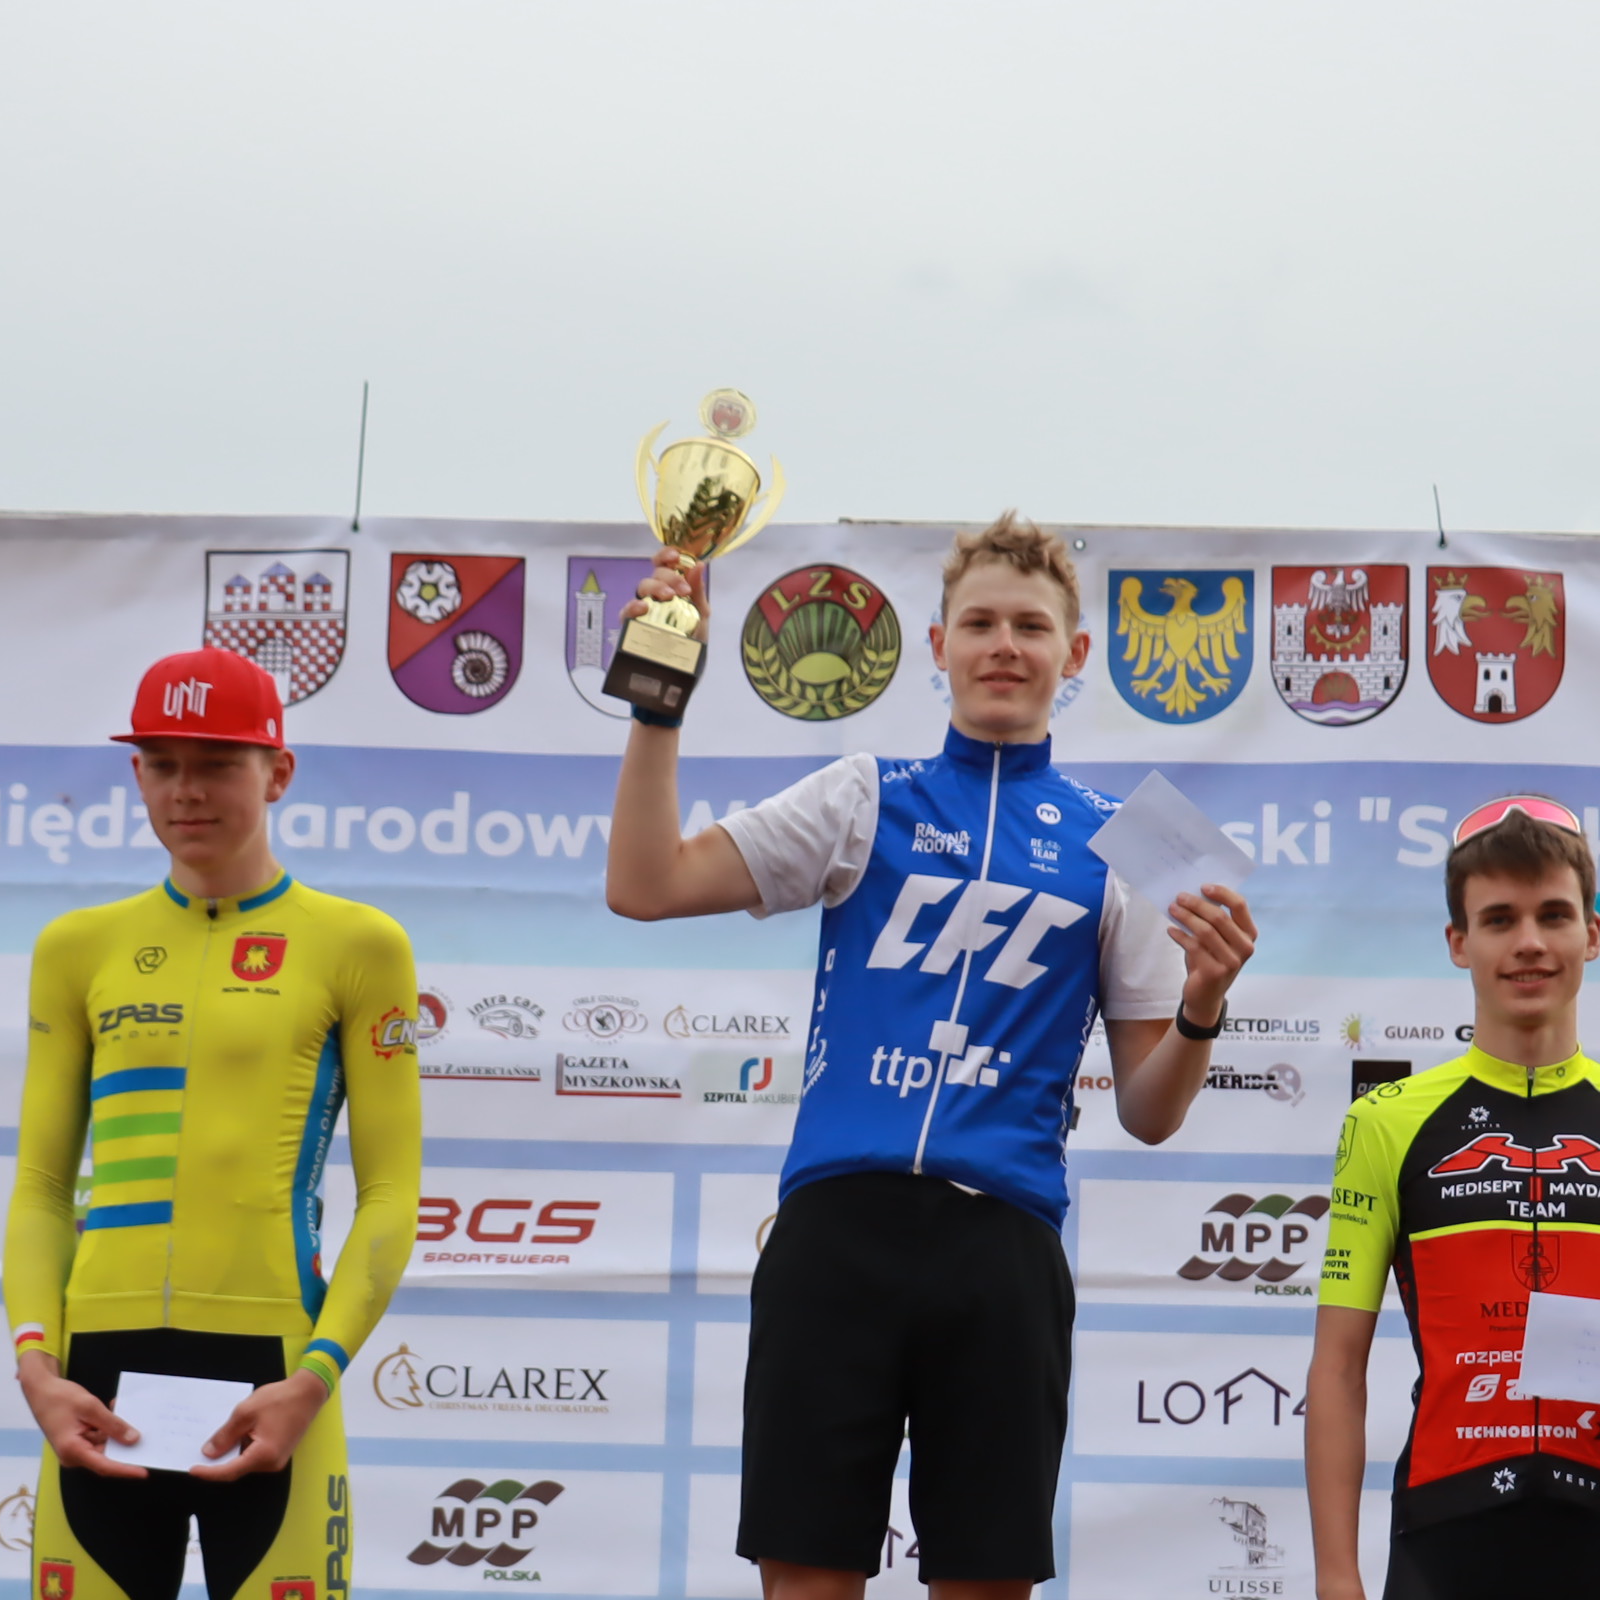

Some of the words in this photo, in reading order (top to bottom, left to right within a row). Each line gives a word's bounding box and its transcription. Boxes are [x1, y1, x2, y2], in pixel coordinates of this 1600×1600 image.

[771, 571, 874, 613] LZS
[1032, 848, 1058, 861] TEAM
[466, 994, 508, 1018] intra
[513, 994, 546, 1019] cars
[692, 1014, 791, 1034] CLAREX
[1222, 1017, 1320, 1034] ECTOPLUS
[1385, 1025, 1445, 1041] GUARD
[564, 1055, 629, 1069] GAZETA
[869, 1045, 933, 1098] ttp
[564, 1075, 682, 1090] MYSZKOWSKA
[703, 1092, 748, 1104] SZPITAL
[1441, 1180, 1522, 1199] MEDISEPT
[1332, 1187, 1378, 1212] ISEPT
[1507, 1200, 1566, 1218] TEAM
[1201, 1222, 1309, 1253] MPP
[423, 1252, 570, 1265] SPORTSWEAR
[1339, 1249, 1351, 1258] BY
[1255, 1285, 1312, 1296] POLSKA
[425, 1365, 610, 1402] CLAREX
[1456, 1425, 1577, 1439] TECHNOBETON
[432, 1507, 538, 1539] MPP
[483, 1570, 541, 1581] POLSKA
[1209, 1579, 1284, 1594] ULISSE
